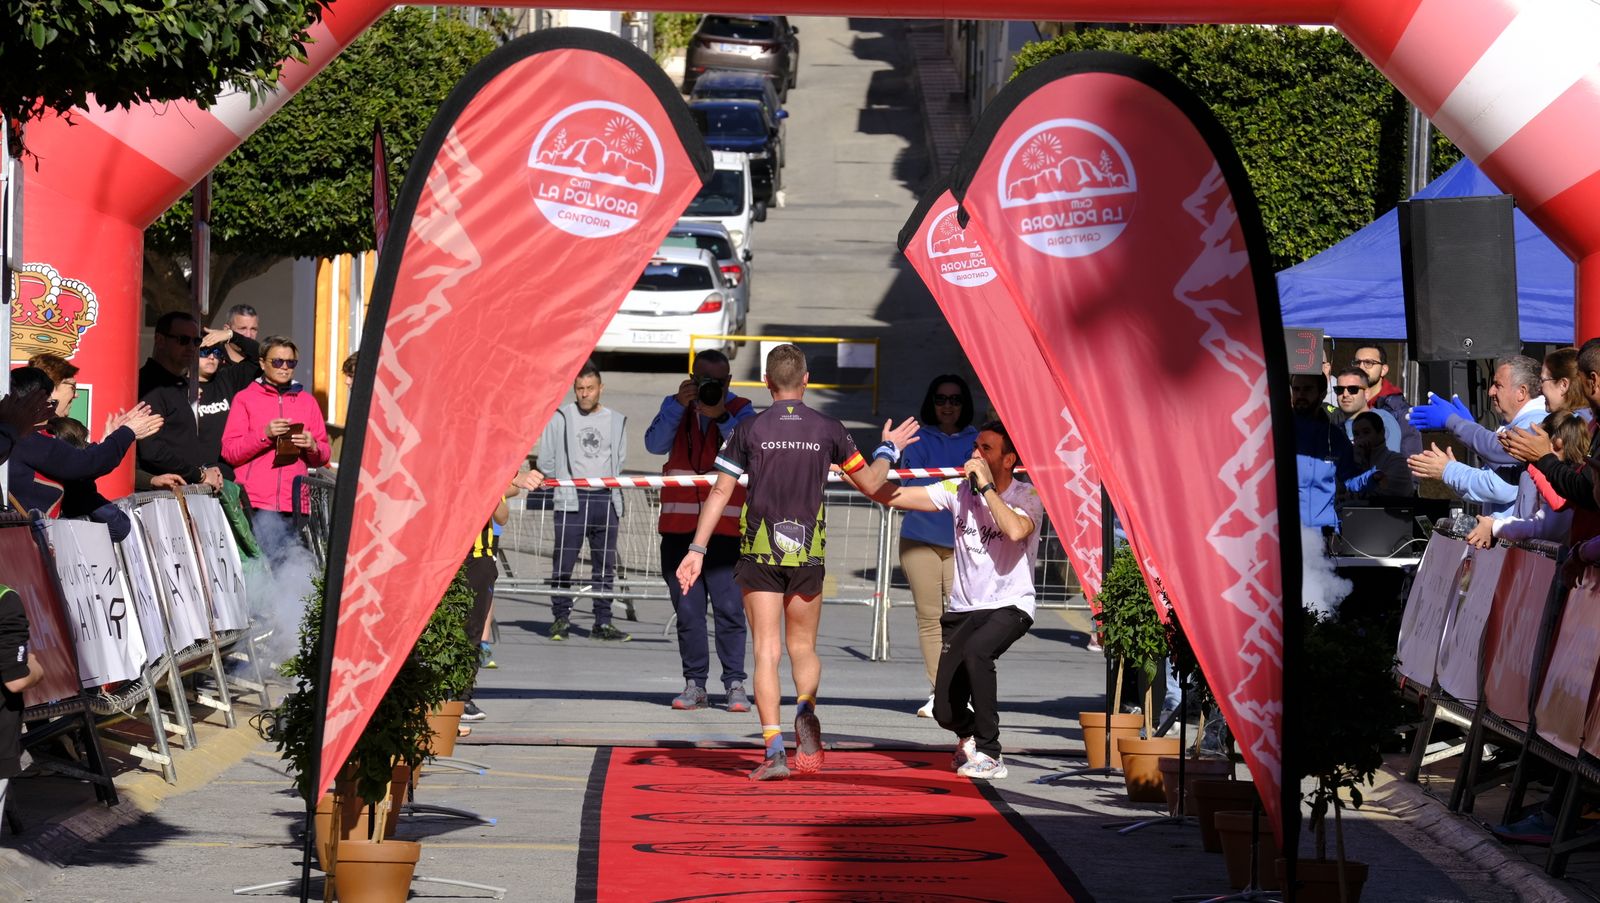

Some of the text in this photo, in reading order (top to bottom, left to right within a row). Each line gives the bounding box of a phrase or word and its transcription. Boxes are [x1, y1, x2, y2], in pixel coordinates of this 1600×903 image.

[538, 182, 560, 200] LA
[557, 209, 611, 229] CANTORIA
[761, 441, 821, 452] COSENTINO
